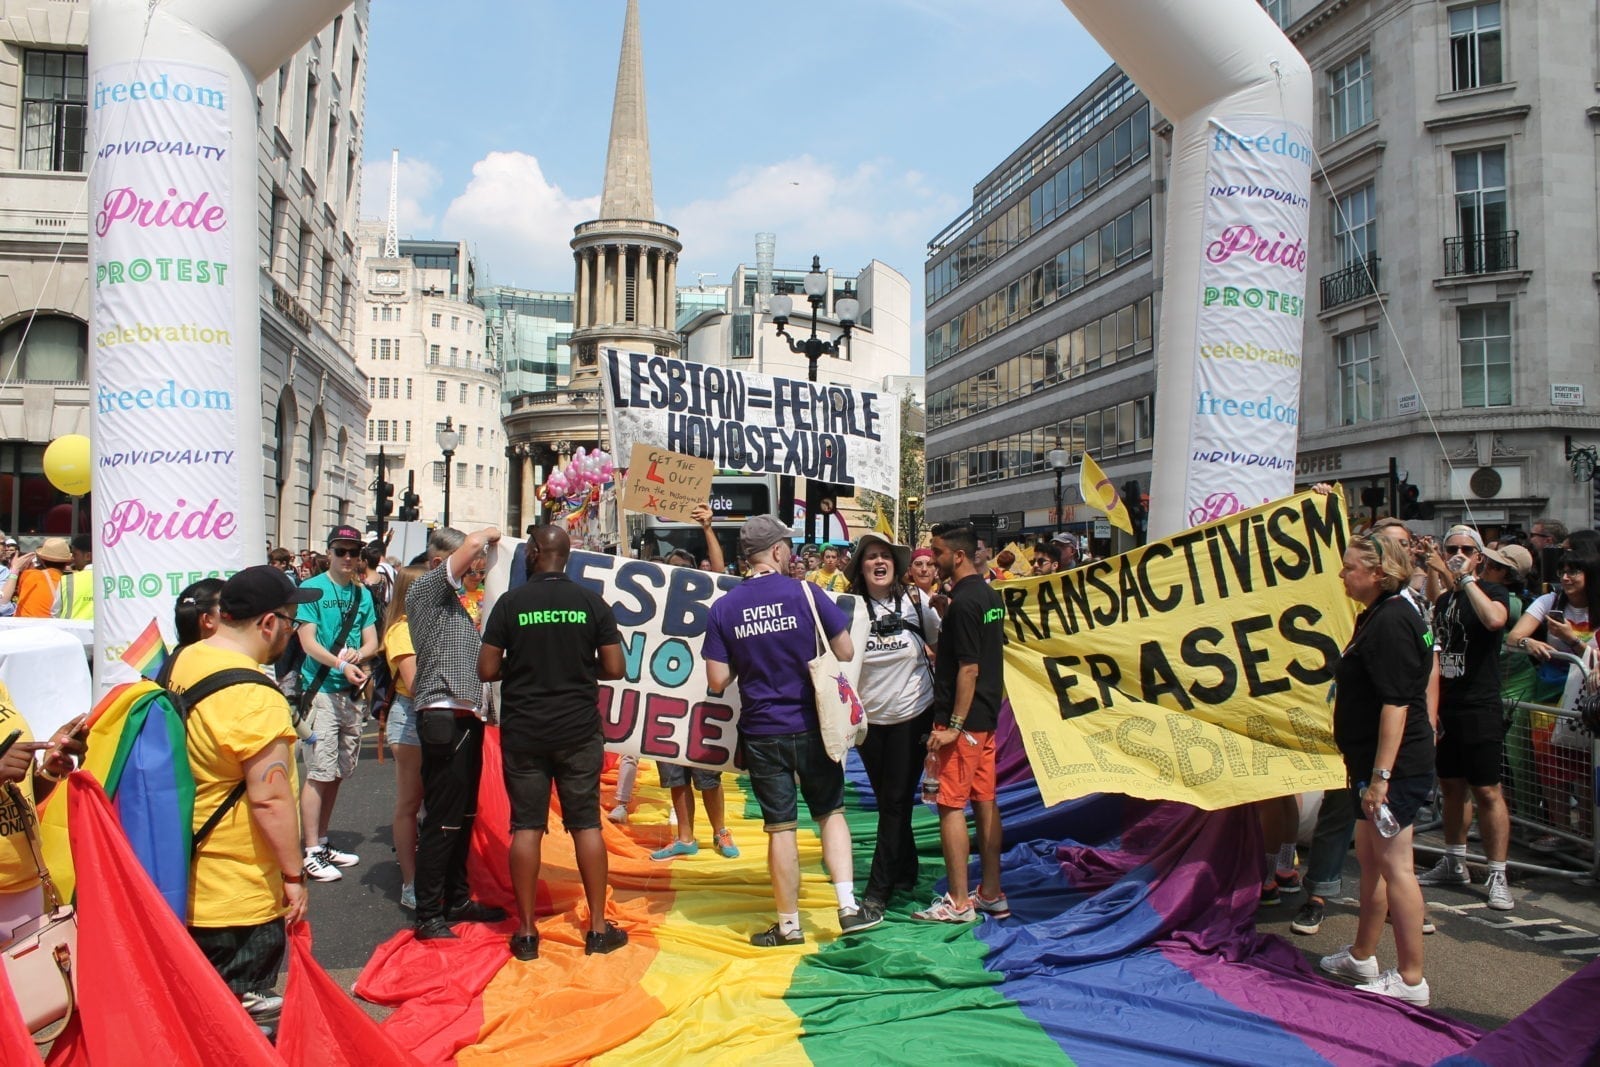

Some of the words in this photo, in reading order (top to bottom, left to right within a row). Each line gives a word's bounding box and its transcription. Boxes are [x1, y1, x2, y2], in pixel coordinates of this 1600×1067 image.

[94, 74, 225, 112] freedom
[97, 140, 226, 161] NDIVIDUALITY
[1214, 128, 1311, 167] freedom
[96, 186, 227, 238] Pride
[1206, 224, 1306, 273] Pride
[96, 257, 228, 289] PROTEST
[97, 321, 231, 347] celebration
[98, 379, 233, 415] freedom
[1197, 389, 1298, 426] freedom
[99, 449, 235, 468] INDIVIDUALITY
[648, 452, 672, 464] GET
[677, 459, 696, 471] THE
[667, 412, 856, 485] HOMOSEXUAL
[646, 461, 665, 485] L
[669, 471, 703, 490] OUT!
[708, 496, 733, 511] vate
[102, 498, 238, 548] Pride
[518, 610, 588, 626] DIRECTOR
[734, 615, 798, 640] MANAGER
[742, 603, 784, 623] EVENT
[1043, 603, 1340, 721] ERASES
[598, 684, 750, 770] UEE
[1031, 705, 1338, 788] LESBIAN
